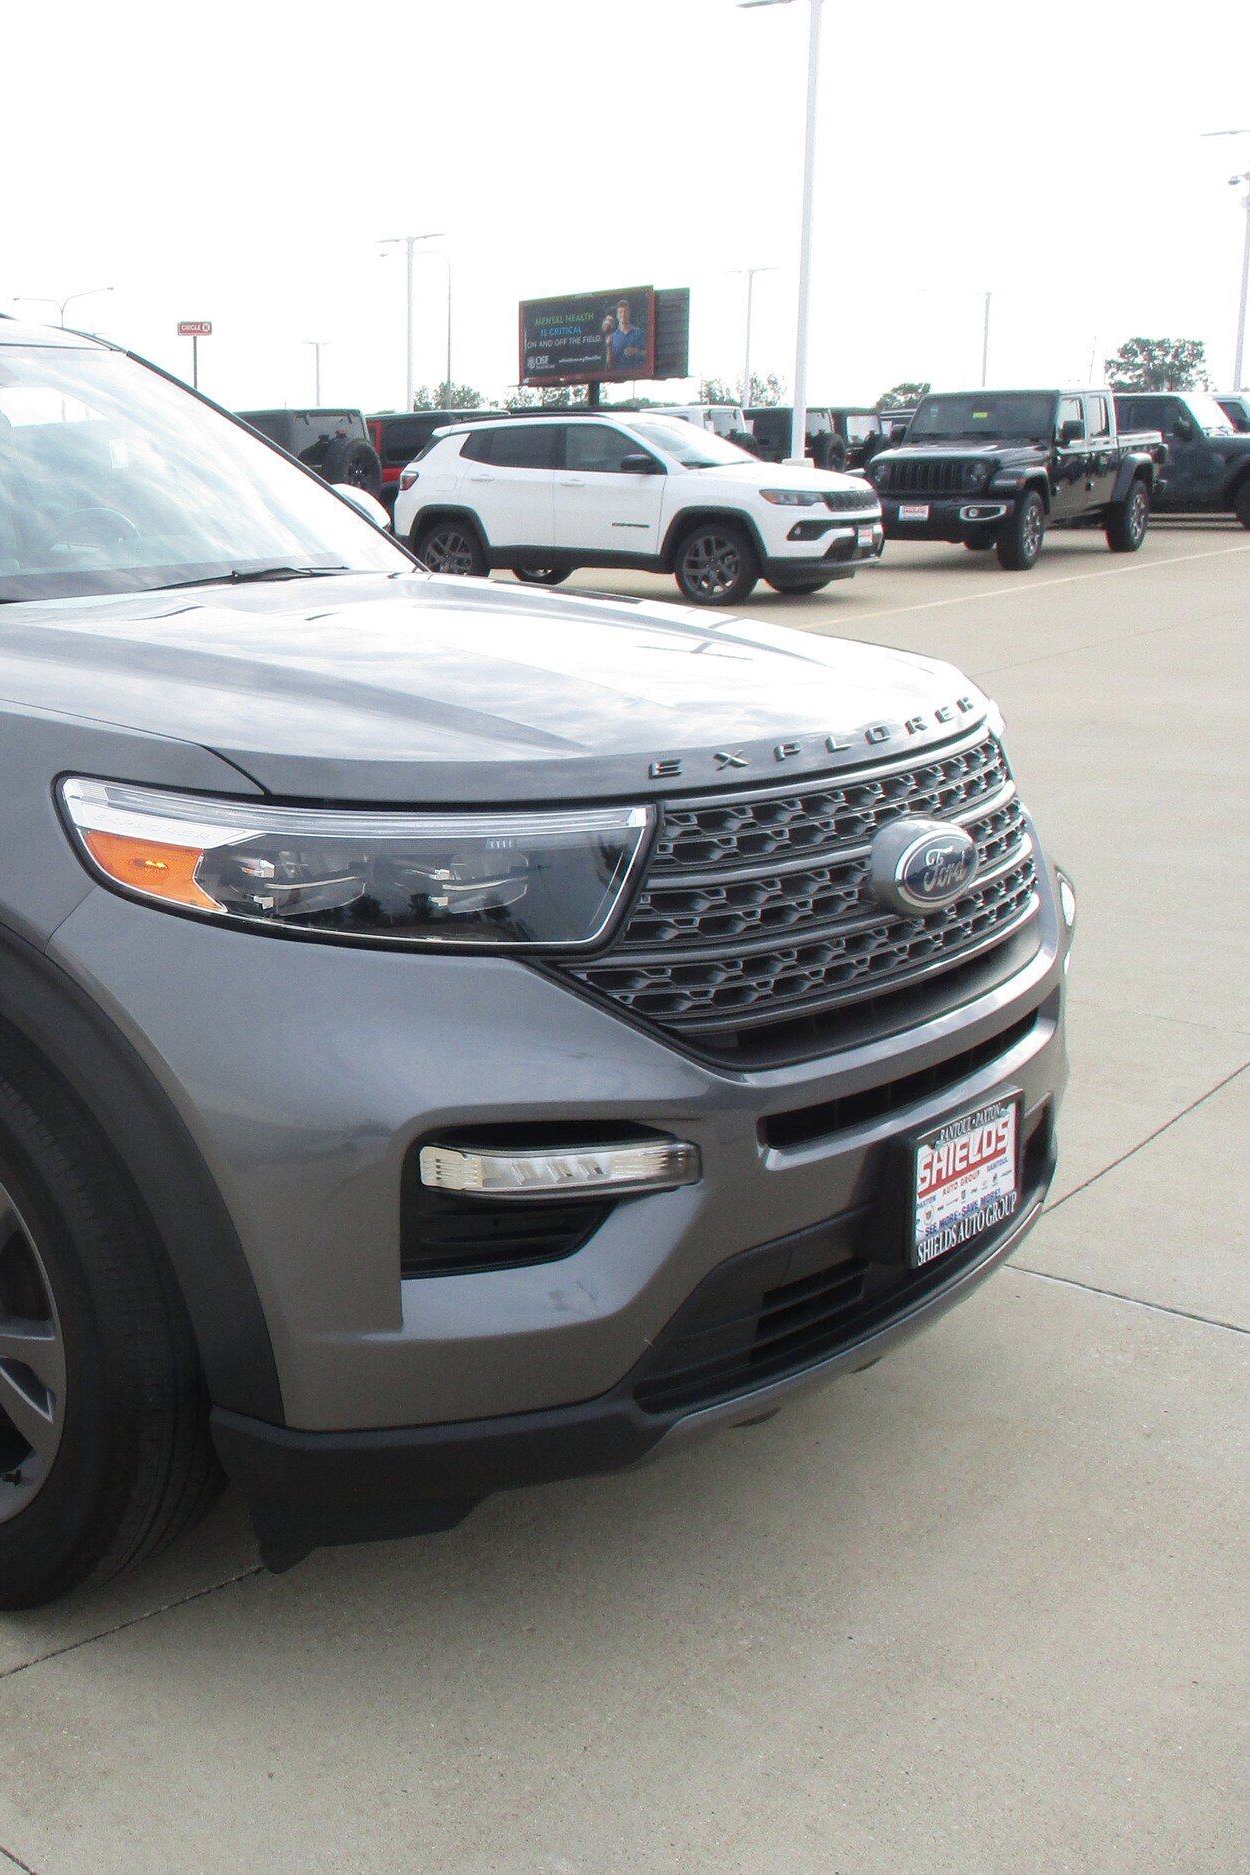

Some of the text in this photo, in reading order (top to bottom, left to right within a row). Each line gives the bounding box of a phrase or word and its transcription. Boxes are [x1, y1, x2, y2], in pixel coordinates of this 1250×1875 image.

[535, 312, 594, 325] MENTAL HEALTH
[540, 326, 582, 337] IS CRITICAL
[526, 341, 537, 349] ON
[554, 338, 567, 346] OFF
[535, 355, 549, 365] OSF
[649, 696, 974, 780] EXPLORER
[924, 846, 967, 892] Ford
[917, 1117, 1010, 1190] SHIELDS
[943, 1170, 980, 1196] AUTO GROUP
[918, 1191, 1018, 1267] SHIELDS AUTO GROUP
[925, 1222, 938, 1237] SEE
